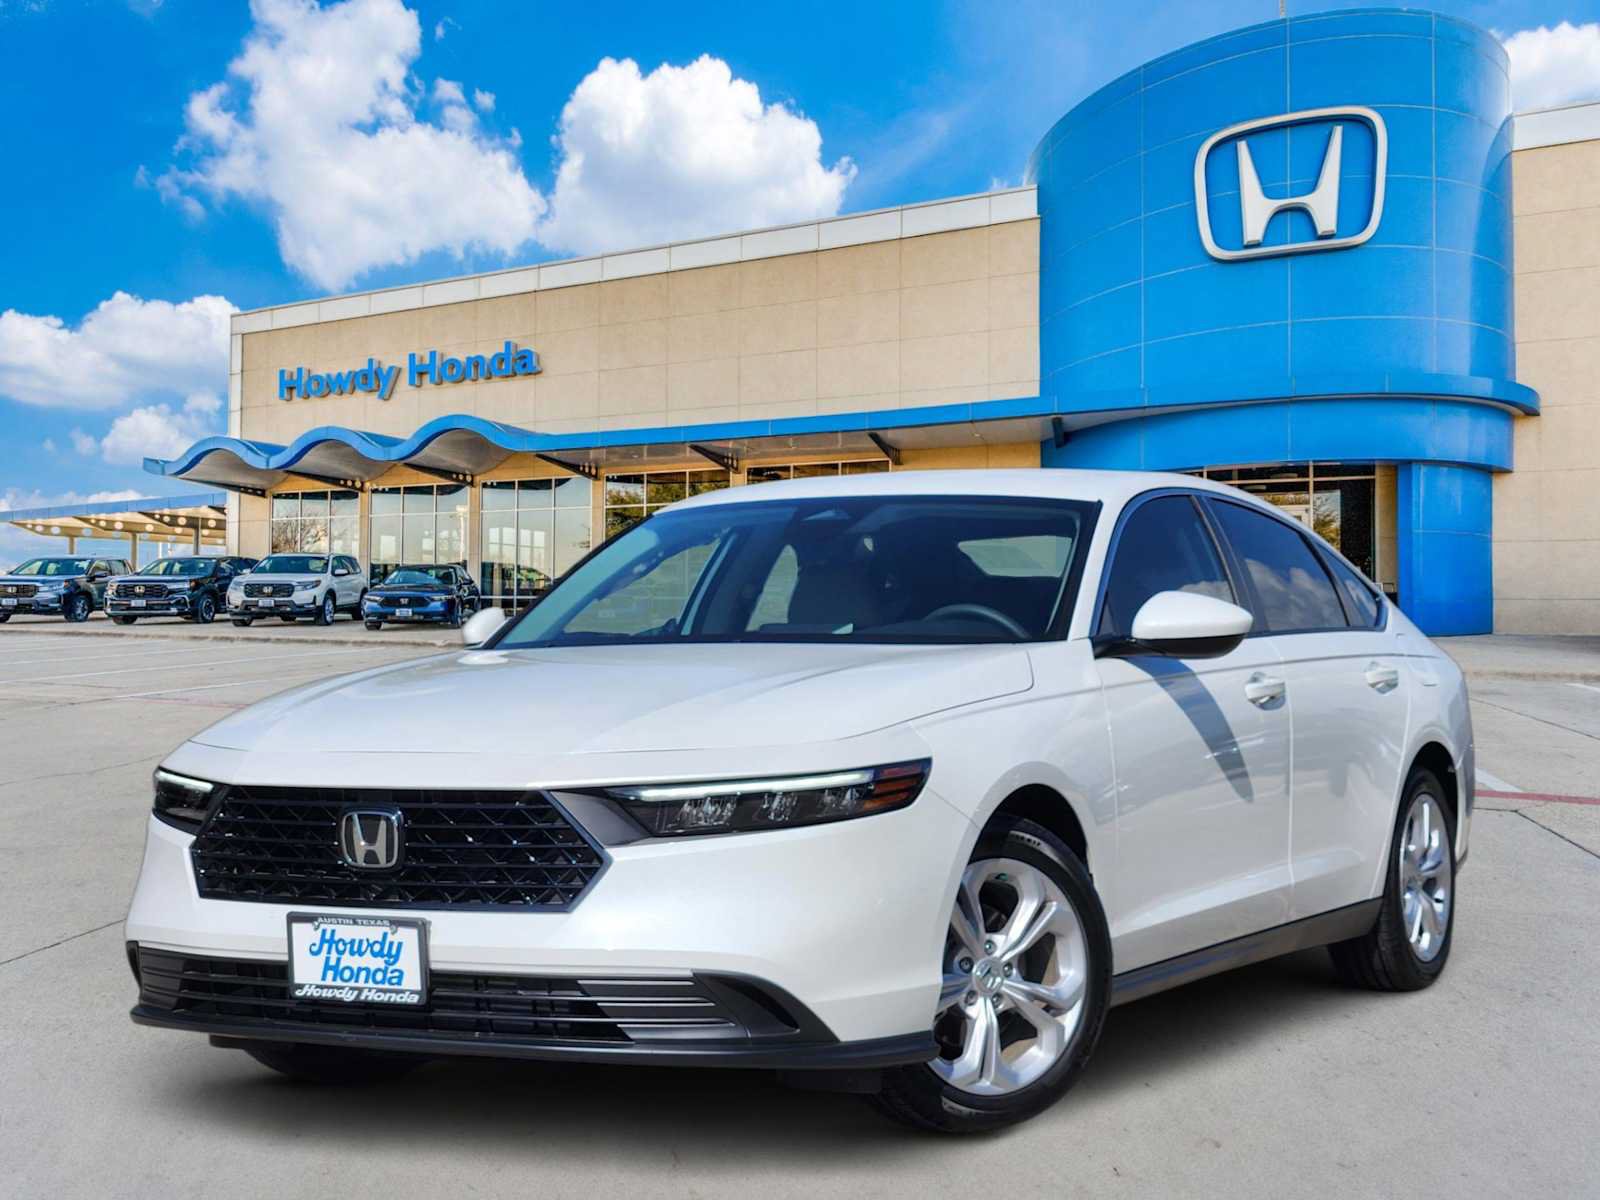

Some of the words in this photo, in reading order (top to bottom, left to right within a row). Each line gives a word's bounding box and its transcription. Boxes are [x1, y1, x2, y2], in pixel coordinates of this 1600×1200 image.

[278, 357, 401, 400] Howdy
[407, 340, 542, 387] Honda
[317, 917, 353, 925] AUSTIN
[309, 927, 404, 966] Howdy
[321, 956, 405, 986] Honda
[295, 984, 359, 1002] Howdy
[360, 988, 420, 1003] Honda
